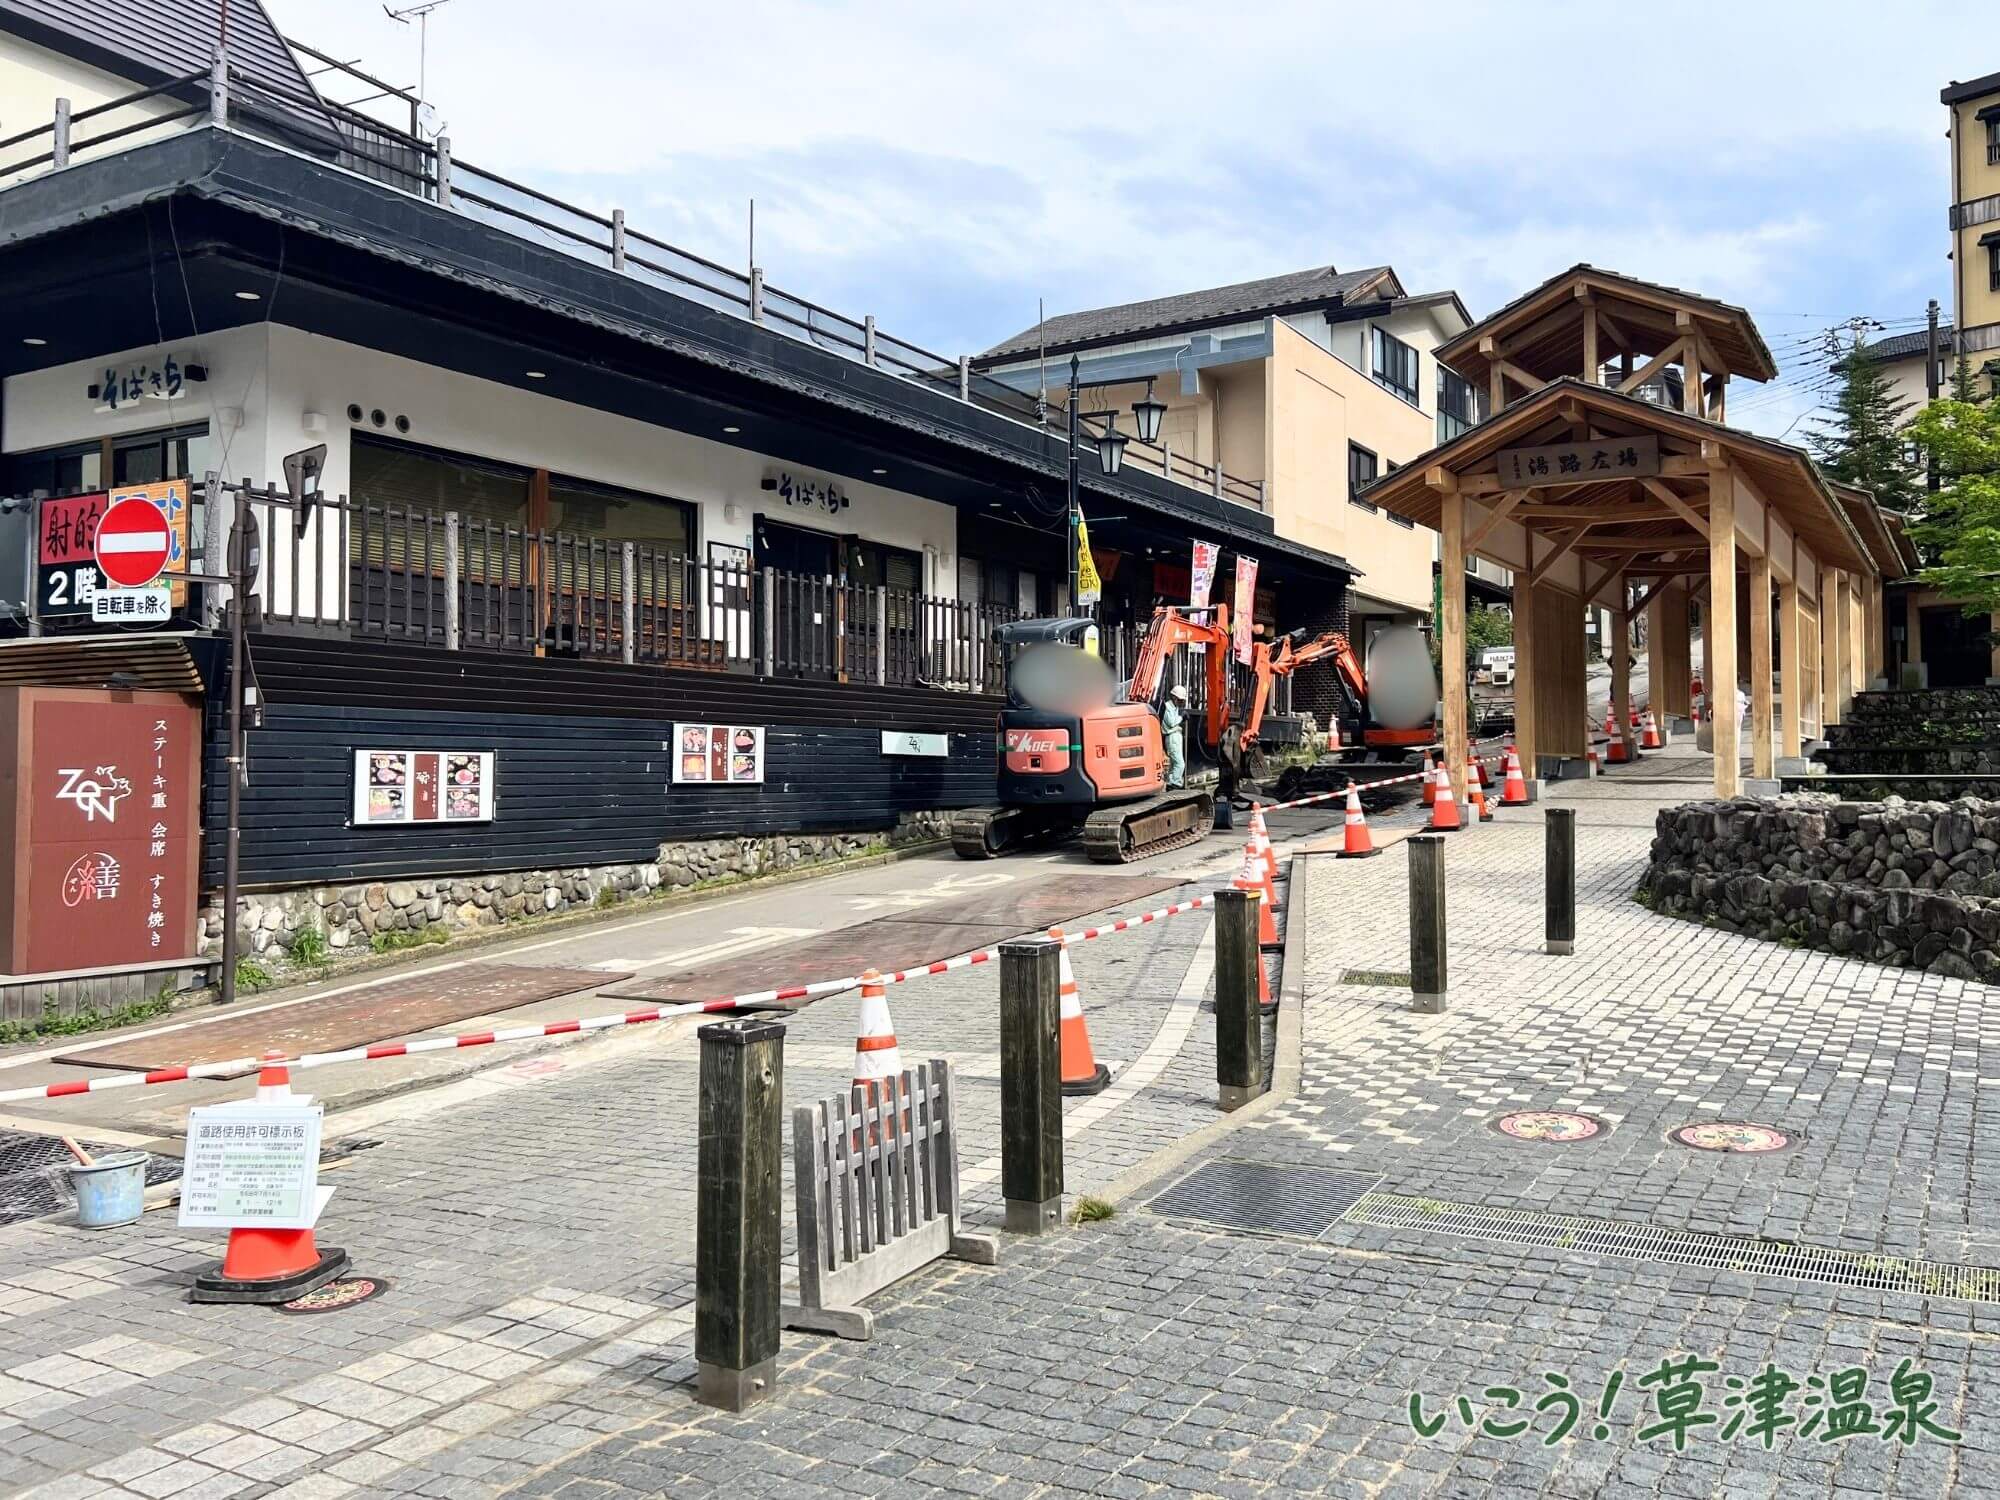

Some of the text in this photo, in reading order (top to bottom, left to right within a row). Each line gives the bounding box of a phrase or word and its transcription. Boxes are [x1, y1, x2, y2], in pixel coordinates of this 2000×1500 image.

[46, 502, 101, 558] 射的
[49, 567, 97, 606] 2階
[96, 595, 168, 616] 自転車を除く
[147, 719, 169, 948] ステーキ重 会席 すき焼き
[199, 1125, 305, 1139] 道路使用許可標示板
